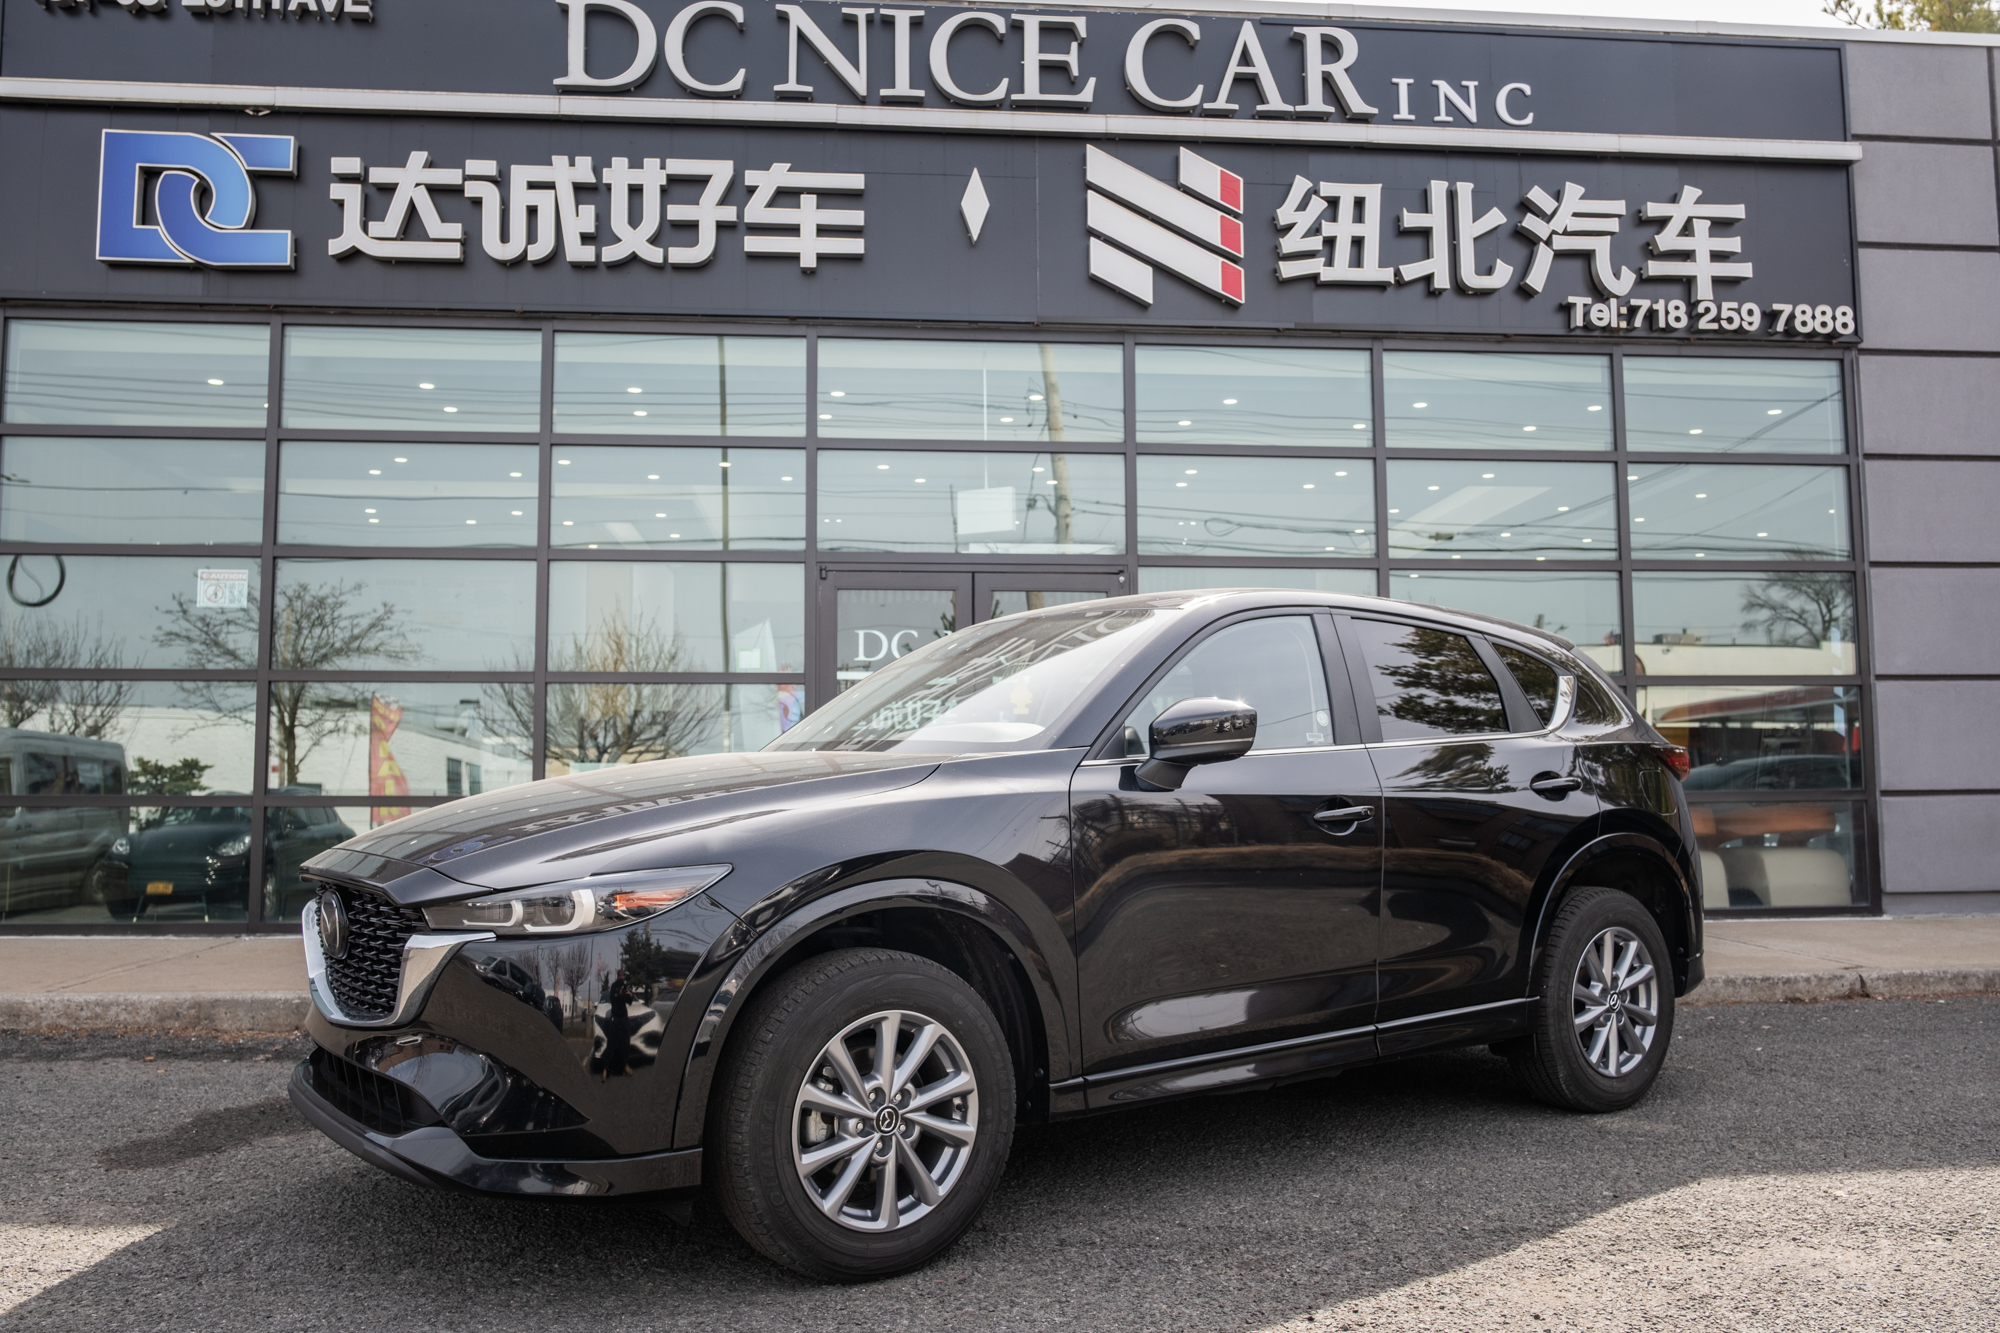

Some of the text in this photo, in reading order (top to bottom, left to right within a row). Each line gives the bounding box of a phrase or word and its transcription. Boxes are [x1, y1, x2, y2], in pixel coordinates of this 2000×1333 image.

[553, 0, 1535, 126] DC NICE CAR INC
[96, 129, 298, 270] DC
[328, 150, 866, 272] 达诚好车
[1274, 174, 1754, 301] 纽北汽车
[1696, 300, 1762, 332] 259
[1770, 302, 1856, 336] 7888
[202, 572, 248, 580] CAUTION
[759, 1100, 819, 1254] YOKOHAMA
